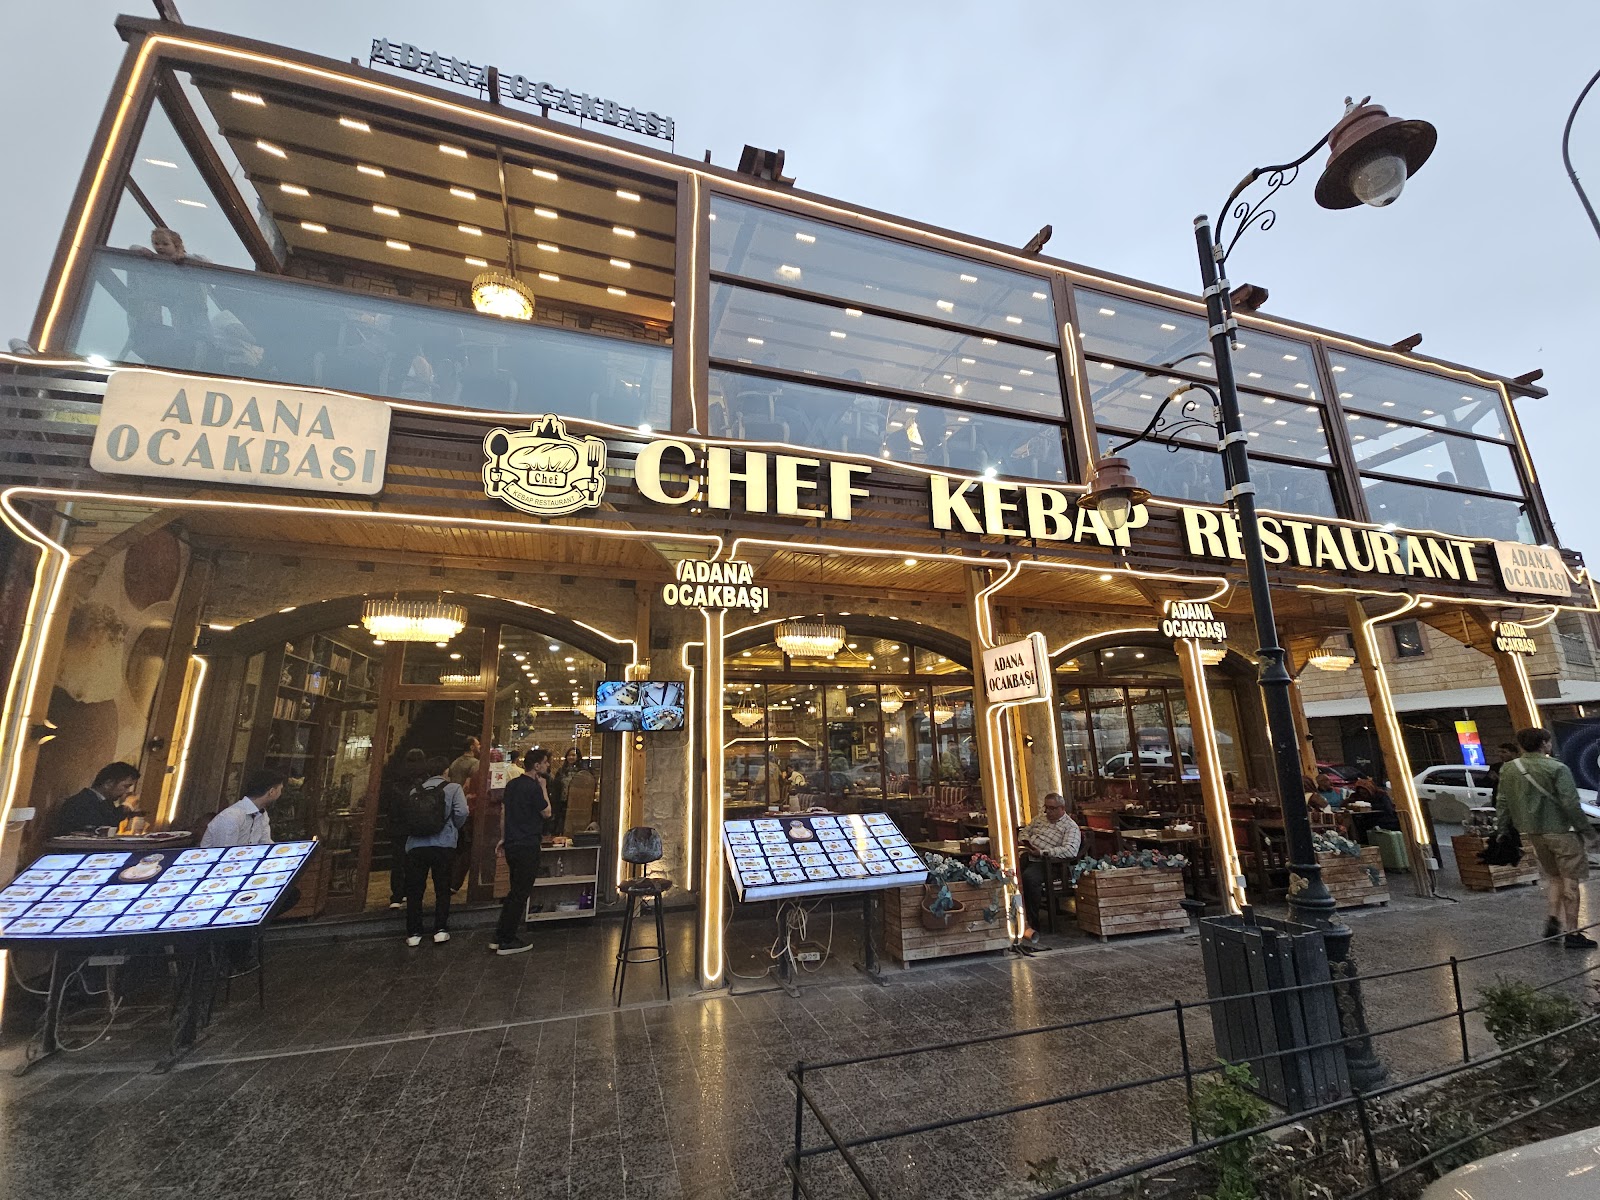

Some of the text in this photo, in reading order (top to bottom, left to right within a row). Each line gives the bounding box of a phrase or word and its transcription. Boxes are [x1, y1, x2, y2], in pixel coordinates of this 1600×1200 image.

[371, 37, 489, 88] ADANA
[160, 388, 335, 440] ADANA
[106, 424, 376, 486] OCAKBAŞI
[534, 472, 558, 485] Chef
[512, 491, 575, 506] KEBAP RESTAURANT
[634, 439, 1478, 581] CHEF KEBAP RESTAURANT
[1511, 548, 1553, 571] ADANA
[681, 561, 752, 585] ADANA
[1504, 566, 1569, 594] OCAKBAŞI
[663, 583, 769, 613] OCAKBAŞI
[1171, 602, 1214, 620] ADANA
[1162, 619, 1228, 643] OCAKBAŞI
[1499, 623, 1527, 638] ADANA
[994, 652, 1025, 673] ADANA
[989, 669, 1036, 692] OCAKBAŞI
